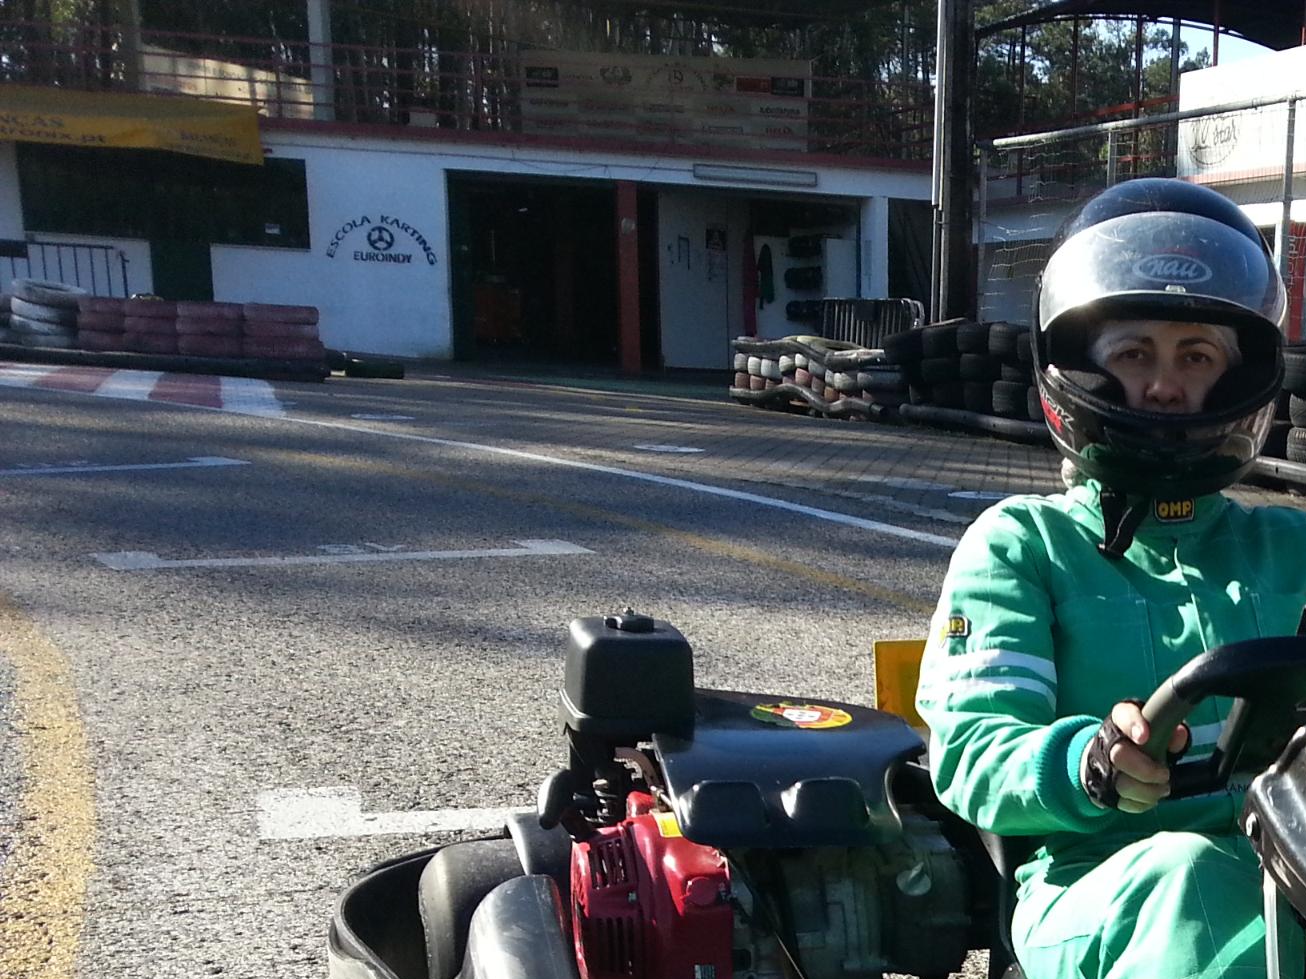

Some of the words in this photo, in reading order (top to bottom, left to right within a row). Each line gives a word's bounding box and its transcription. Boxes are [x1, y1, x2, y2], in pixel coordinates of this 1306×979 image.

[326, 215, 371, 259] ESCOLA
[380, 215, 438, 266] KARTING
[353, 250, 413, 264] EUROINDY
[1158, 501, 1192, 517] OMP
